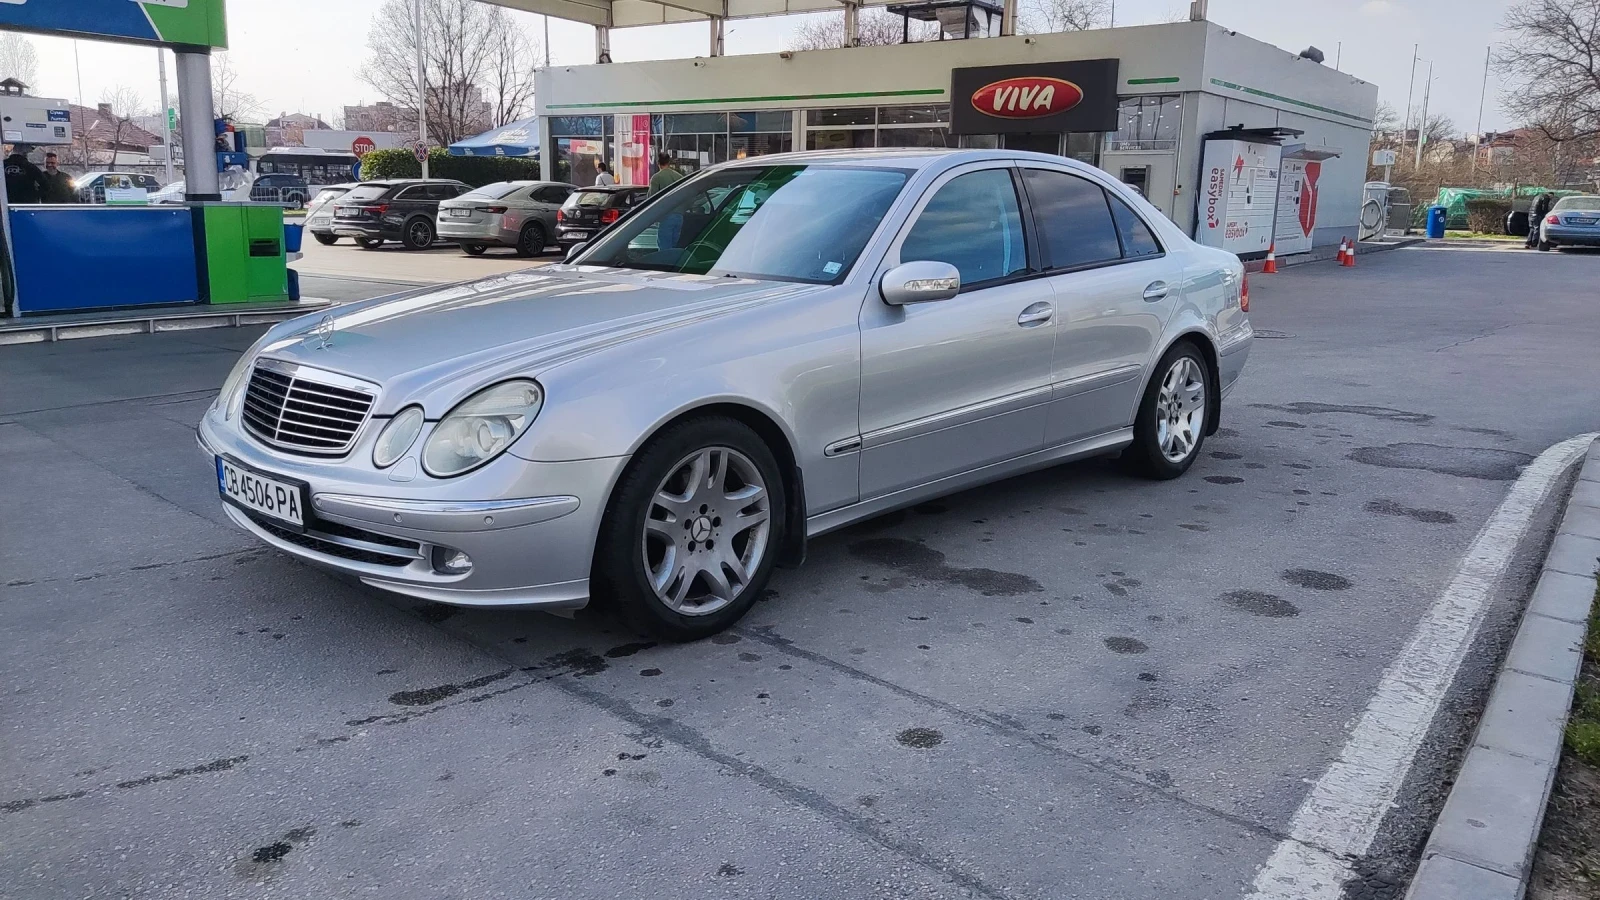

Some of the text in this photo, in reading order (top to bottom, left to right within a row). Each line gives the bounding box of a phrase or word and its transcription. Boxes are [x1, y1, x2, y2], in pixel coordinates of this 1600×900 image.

[993, 84, 1055, 111] VIVA
[354, 143, 374, 153] STOP
[1207, 167, 1219, 221] easybox
